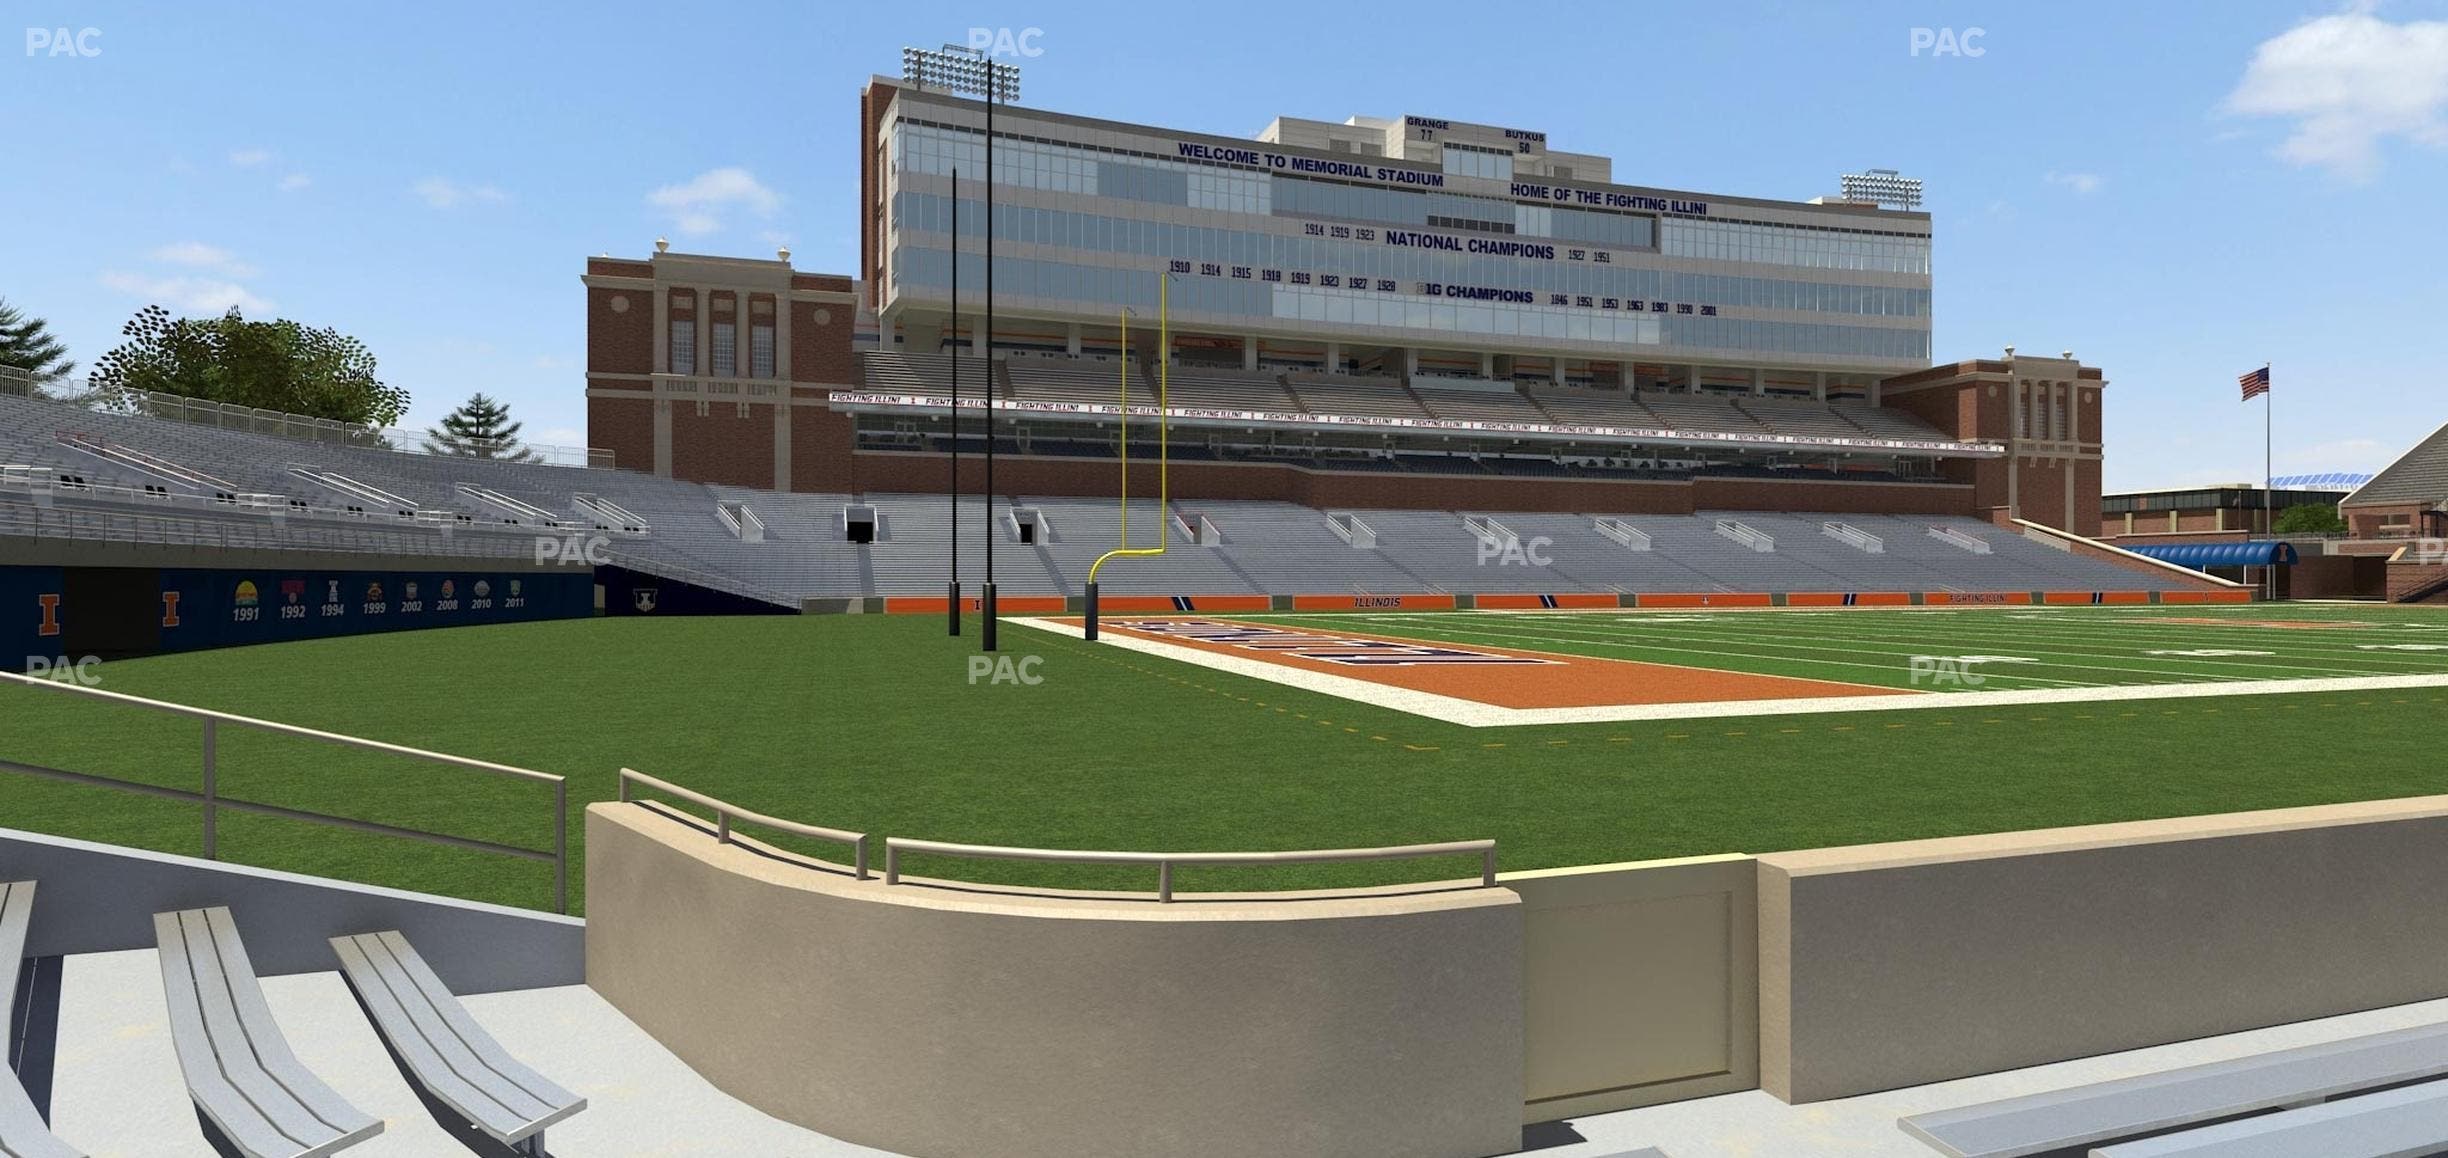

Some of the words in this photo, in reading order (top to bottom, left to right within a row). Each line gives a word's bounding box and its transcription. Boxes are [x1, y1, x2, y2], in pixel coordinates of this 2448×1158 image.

[1407, 117, 1449, 129] GRANGE
[1421, 129, 1432, 140] 77
[1505, 129, 1546, 142] BUTKUS
[1519, 142, 1530, 154] 50
[1178, 142, 1259, 165] WELCOME
[1264, 154, 1286, 168] TO
[1292, 157, 1372, 179] MEMORIAL
[1377, 168, 1443, 187] STADIUM
[1510, 183, 1549, 199] HOME
[1554, 188, 1571, 201] OF
[1575, 190, 1601, 204] THE
[1606, 193, 1667, 212] FIGHTING
[1672, 201, 1706, 215] ILLINI
[1305, 223, 1324, 236] 1914
[1330, 226, 1349, 238] 1919
[1356, 228, 1375, 241] 1923
[1386, 231, 1463, 251] NATIONAL
[1468, 239, 1554, 260] CHAMPIONS
[1170, 260, 1190, 273] 1910
[1201, 263, 1221, 276] 1914
[1232, 266, 1251, 279] 1915
[1446, 285, 1533, 303] CHAMPIONS
[832, 394, 872, 403] FIGHTING
[874, 395, 900, 404] ILLINI
[926, 398, 965, 407] FIGHTNG
[966, 399, 989, 408] ILLIN
[1016, 402, 1053, 411] FIGHTING
[1055, 403, 1079, 412] ILLINI
[362, 602, 386, 615] 1999
[401, 601, 422, 613] 2002
[437, 599, 459, 611] 2008
[471, 598, 492, 610] 2010
[505, 598, 524, 608] 2011
[1354, 597, 1401, 608] ILLINOIS
[39, 594, 60, 636] I
[163, 592, 180, 627] I
[233, 607, 259, 621] 1991
[280, 605, 306, 619] 1992
[321, 603, 345, 616] 1994
